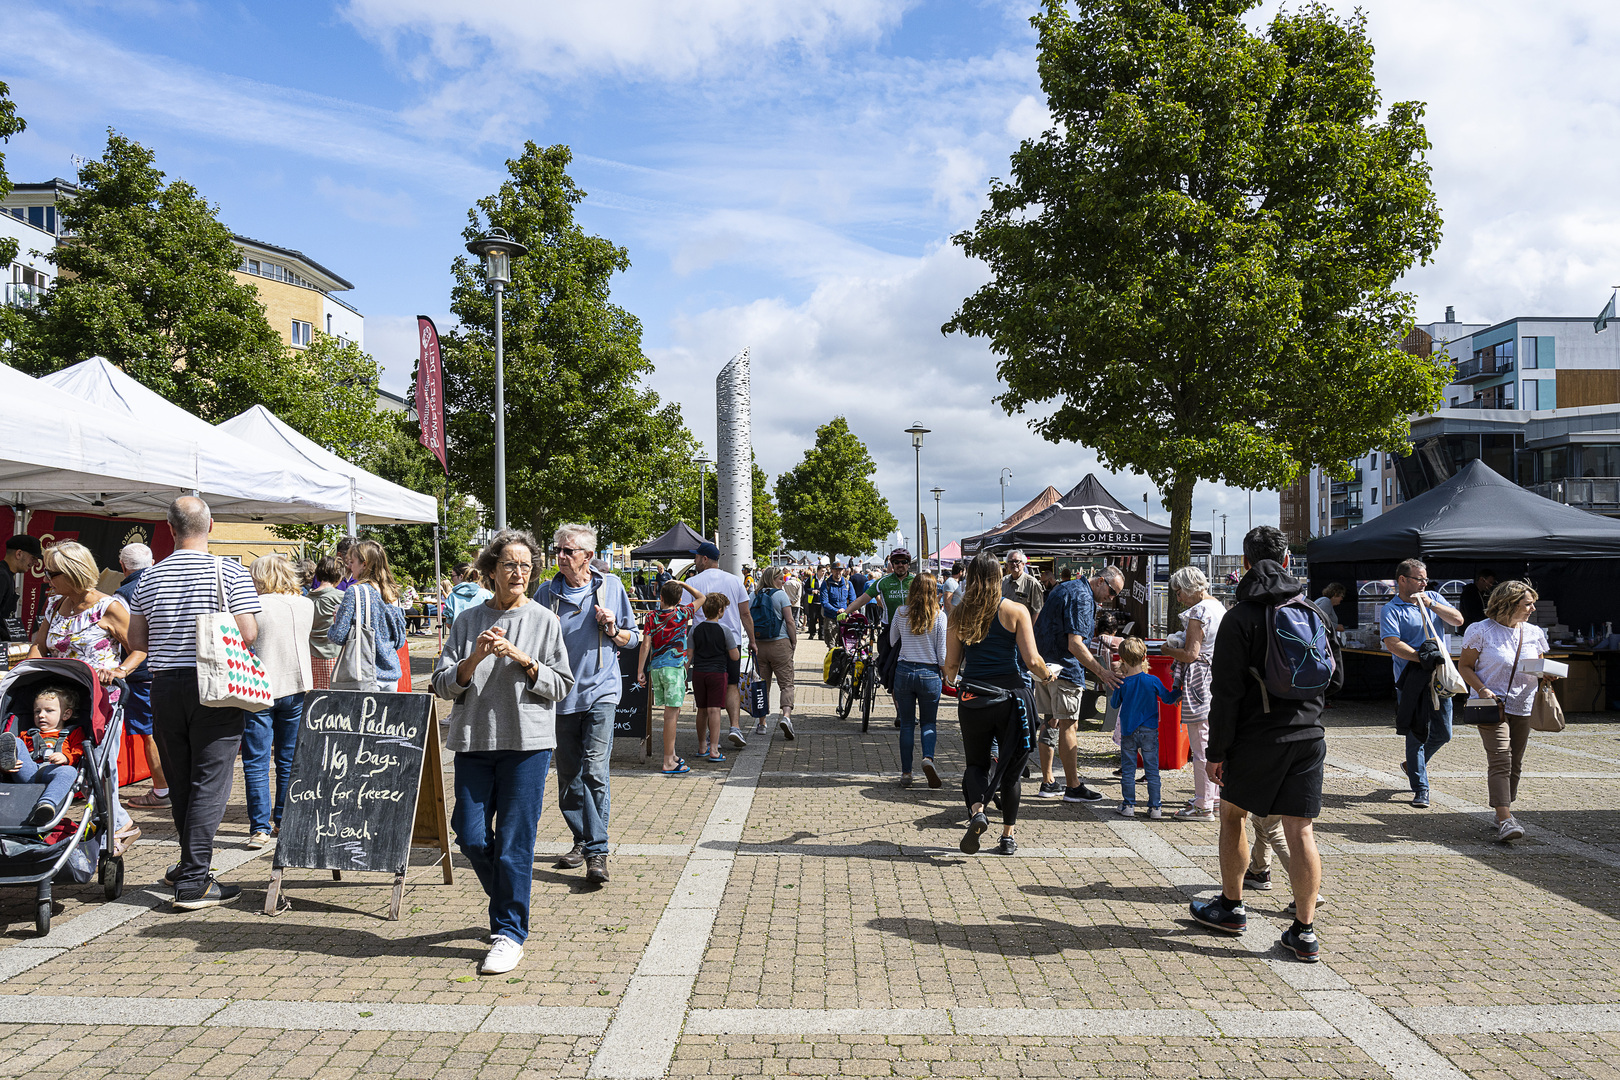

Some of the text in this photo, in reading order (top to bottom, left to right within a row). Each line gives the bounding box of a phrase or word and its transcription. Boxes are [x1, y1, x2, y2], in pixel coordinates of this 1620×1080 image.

[1080, 533, 1143, 542] SOMERSET
[358, 696, 418, 739] Padano
[321, 735, 348, 779] 1kg
[289, 779, 404, 808] Great for freezer
[316, 809, 342, 843] £5
